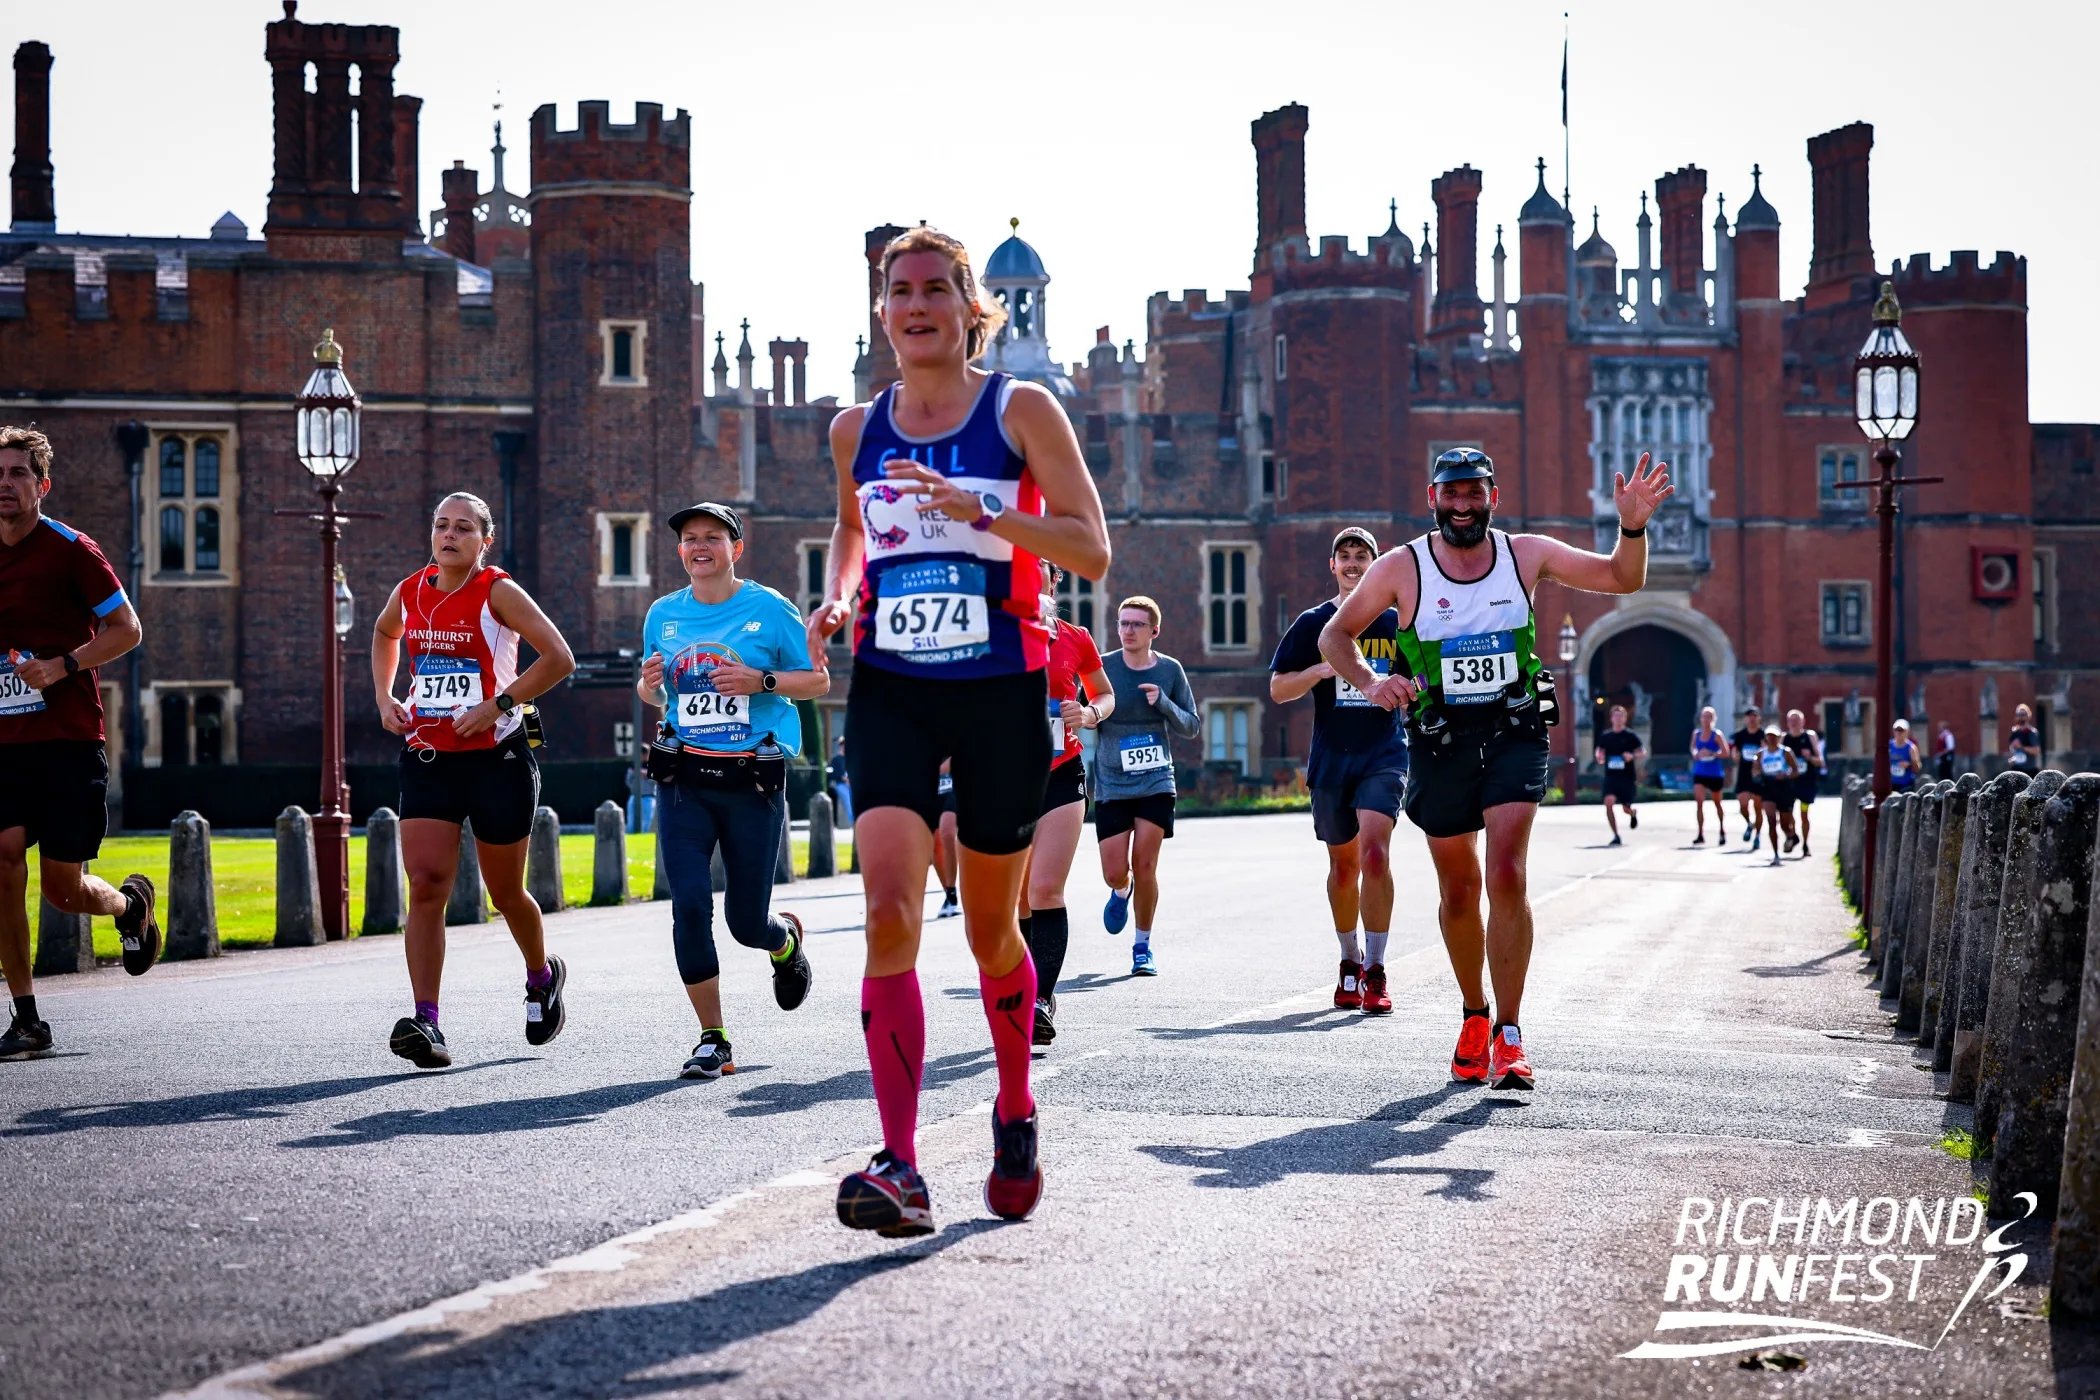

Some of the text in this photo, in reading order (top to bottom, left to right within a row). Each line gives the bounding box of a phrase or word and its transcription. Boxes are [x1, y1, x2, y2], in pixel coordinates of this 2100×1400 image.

[921, 524, 948, 539] UK
[901, 567, 946, 580] CAYMAN
[902, 577, 947, 589] ISLANDS
[889, 597, 971, 635] 6574
[408, 629, 474, 643] SANDHURST
[1457, 637, 1490, 646] CAYMAN
[420, 641, 455, 651] JOGGERS
[1453, 656, 1506, 684] 5381
[422, 675, 471, 699] 5749
[686, 694, 738, 716] 6216
[1455, 694, 1495, 704] RICHMOND
[689, 724, 741, 734] RICHMOND 26.2
[730, 733, 746, 741] 6216
[1128, 747, 1159, 766] 5952
